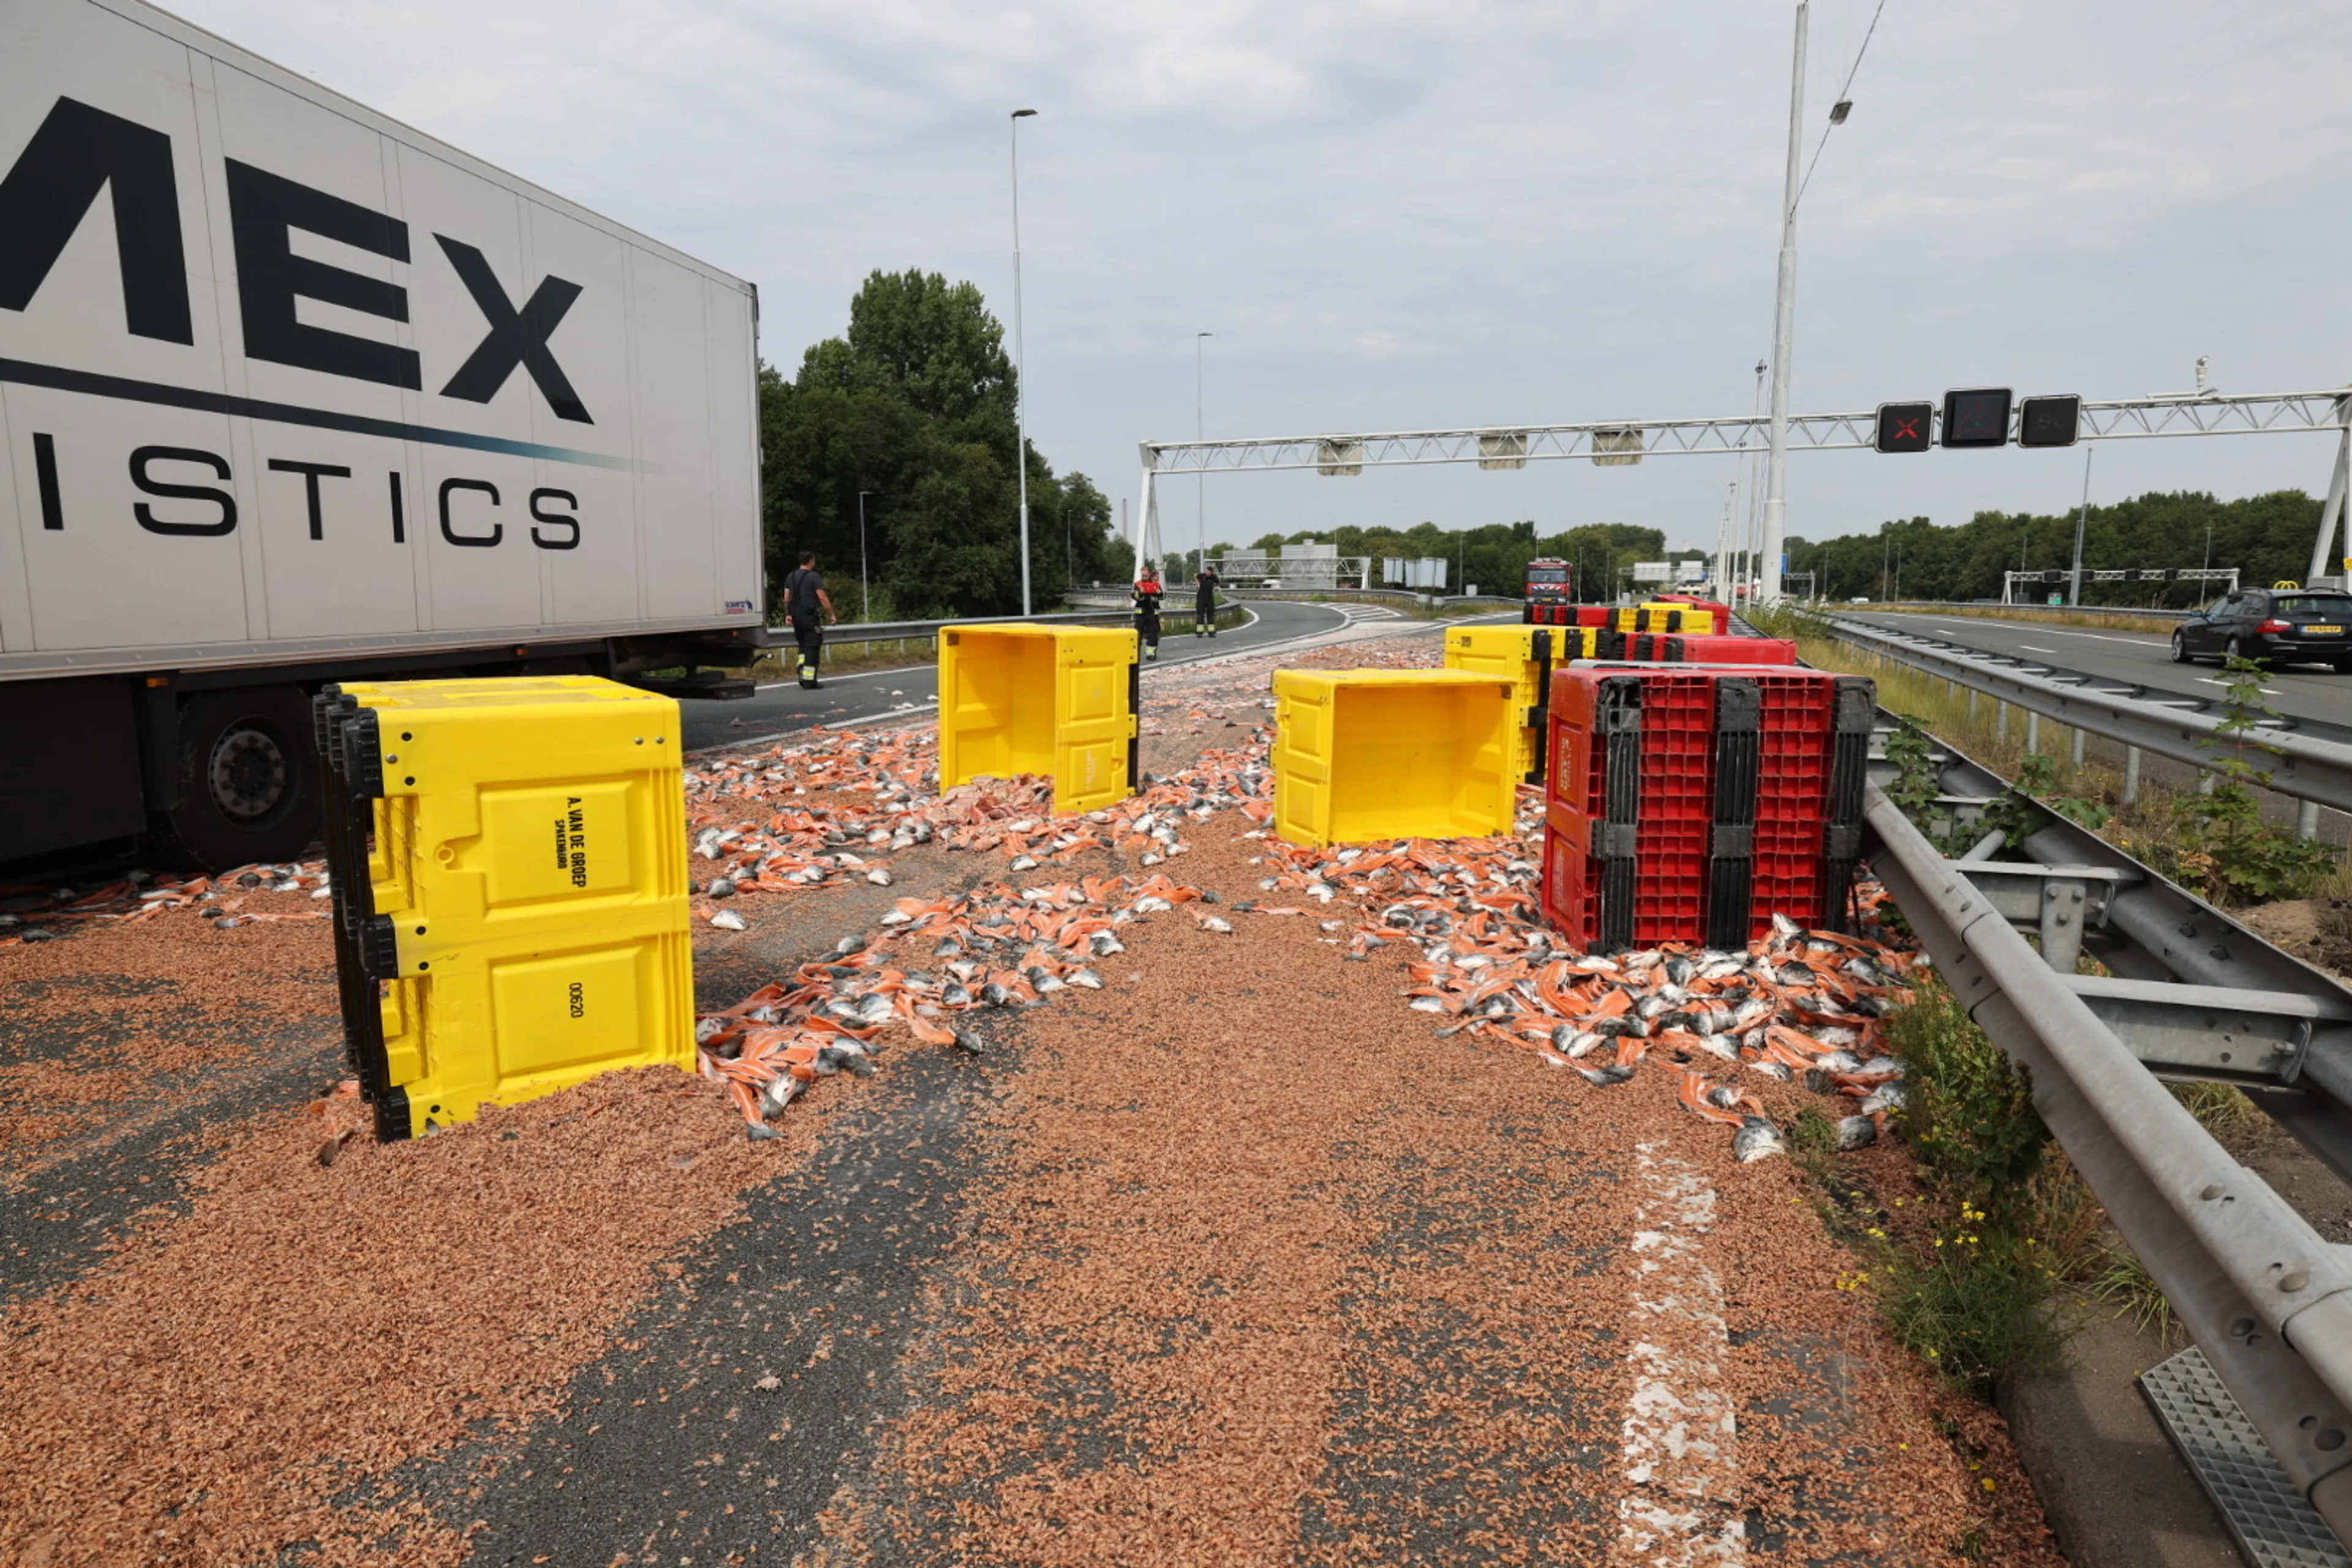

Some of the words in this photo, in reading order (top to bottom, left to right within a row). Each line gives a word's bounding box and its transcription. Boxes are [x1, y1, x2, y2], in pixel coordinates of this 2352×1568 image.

[567, 797, 582, 808] A.
[568, 809, 583, 832] VAN
[570, 835, 584, 850] DE
[570, 852, 586, 888] GROEP
[569, 982, 584, 1019] 00620
